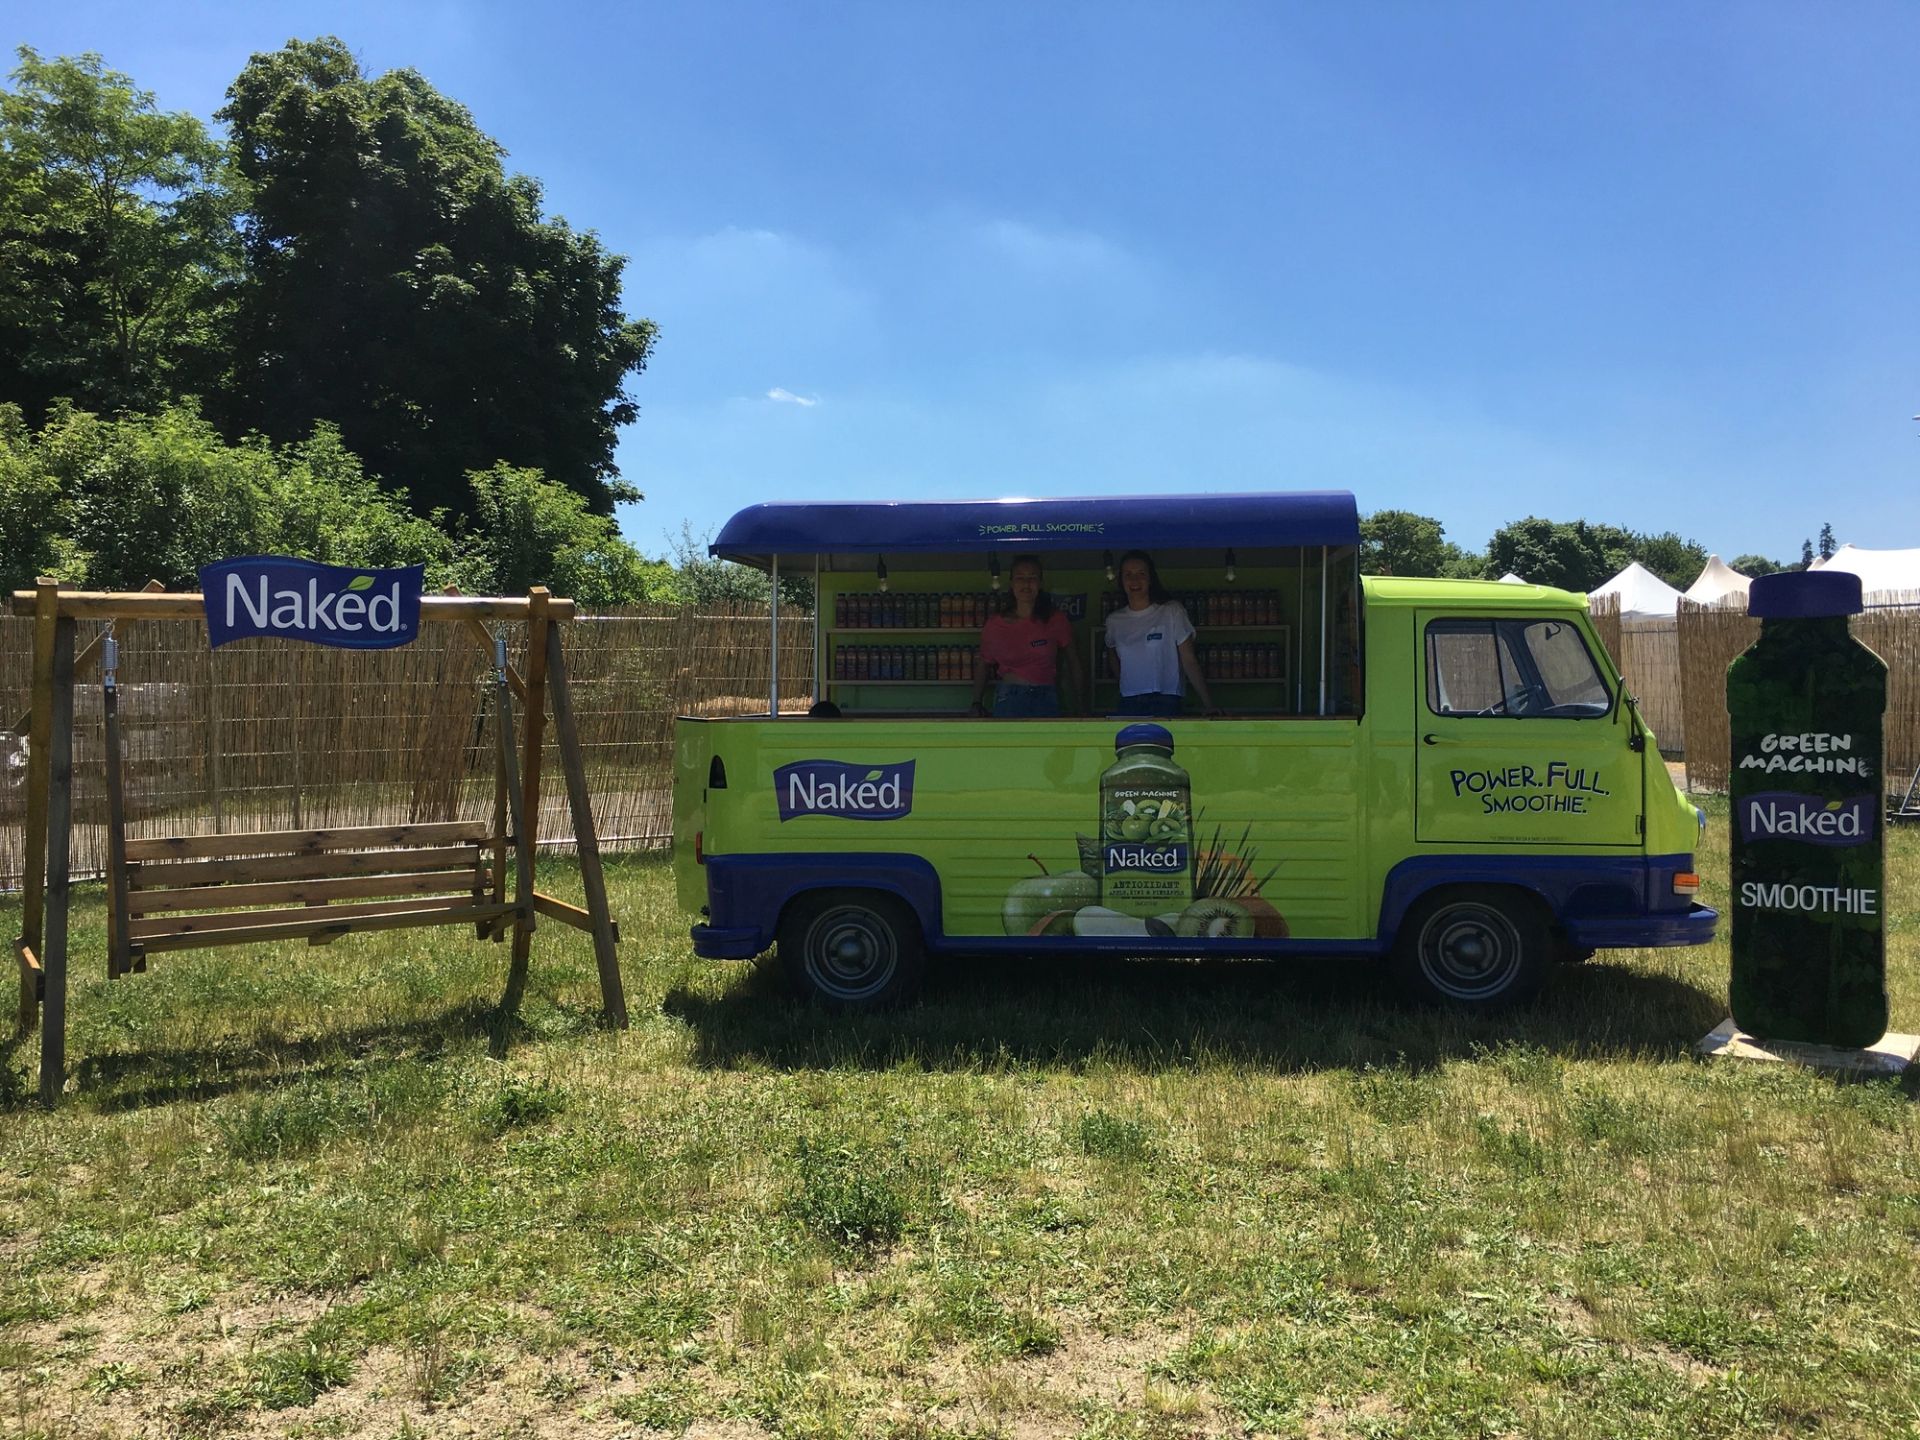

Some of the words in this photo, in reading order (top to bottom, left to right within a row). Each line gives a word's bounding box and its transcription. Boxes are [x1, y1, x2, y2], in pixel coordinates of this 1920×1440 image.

[226, 573, 400, 633] Naked
[1760, 732, 1851, 753] GREEN
[789, 772, 900, 810] Naked
[1115, 790, 1139, 798] GREEN
[1450, 765, 1543, 797] POWER.
[1547, 761, 1610, 796] FULL.
[1750, 801, 1860, 837] Naked
[1109, 848, 1177, 868] Naked
[1113, 881, 1180, 889] ANTIOXIDANT
[1740, 882, 1877, 915] SMOOTHIE
